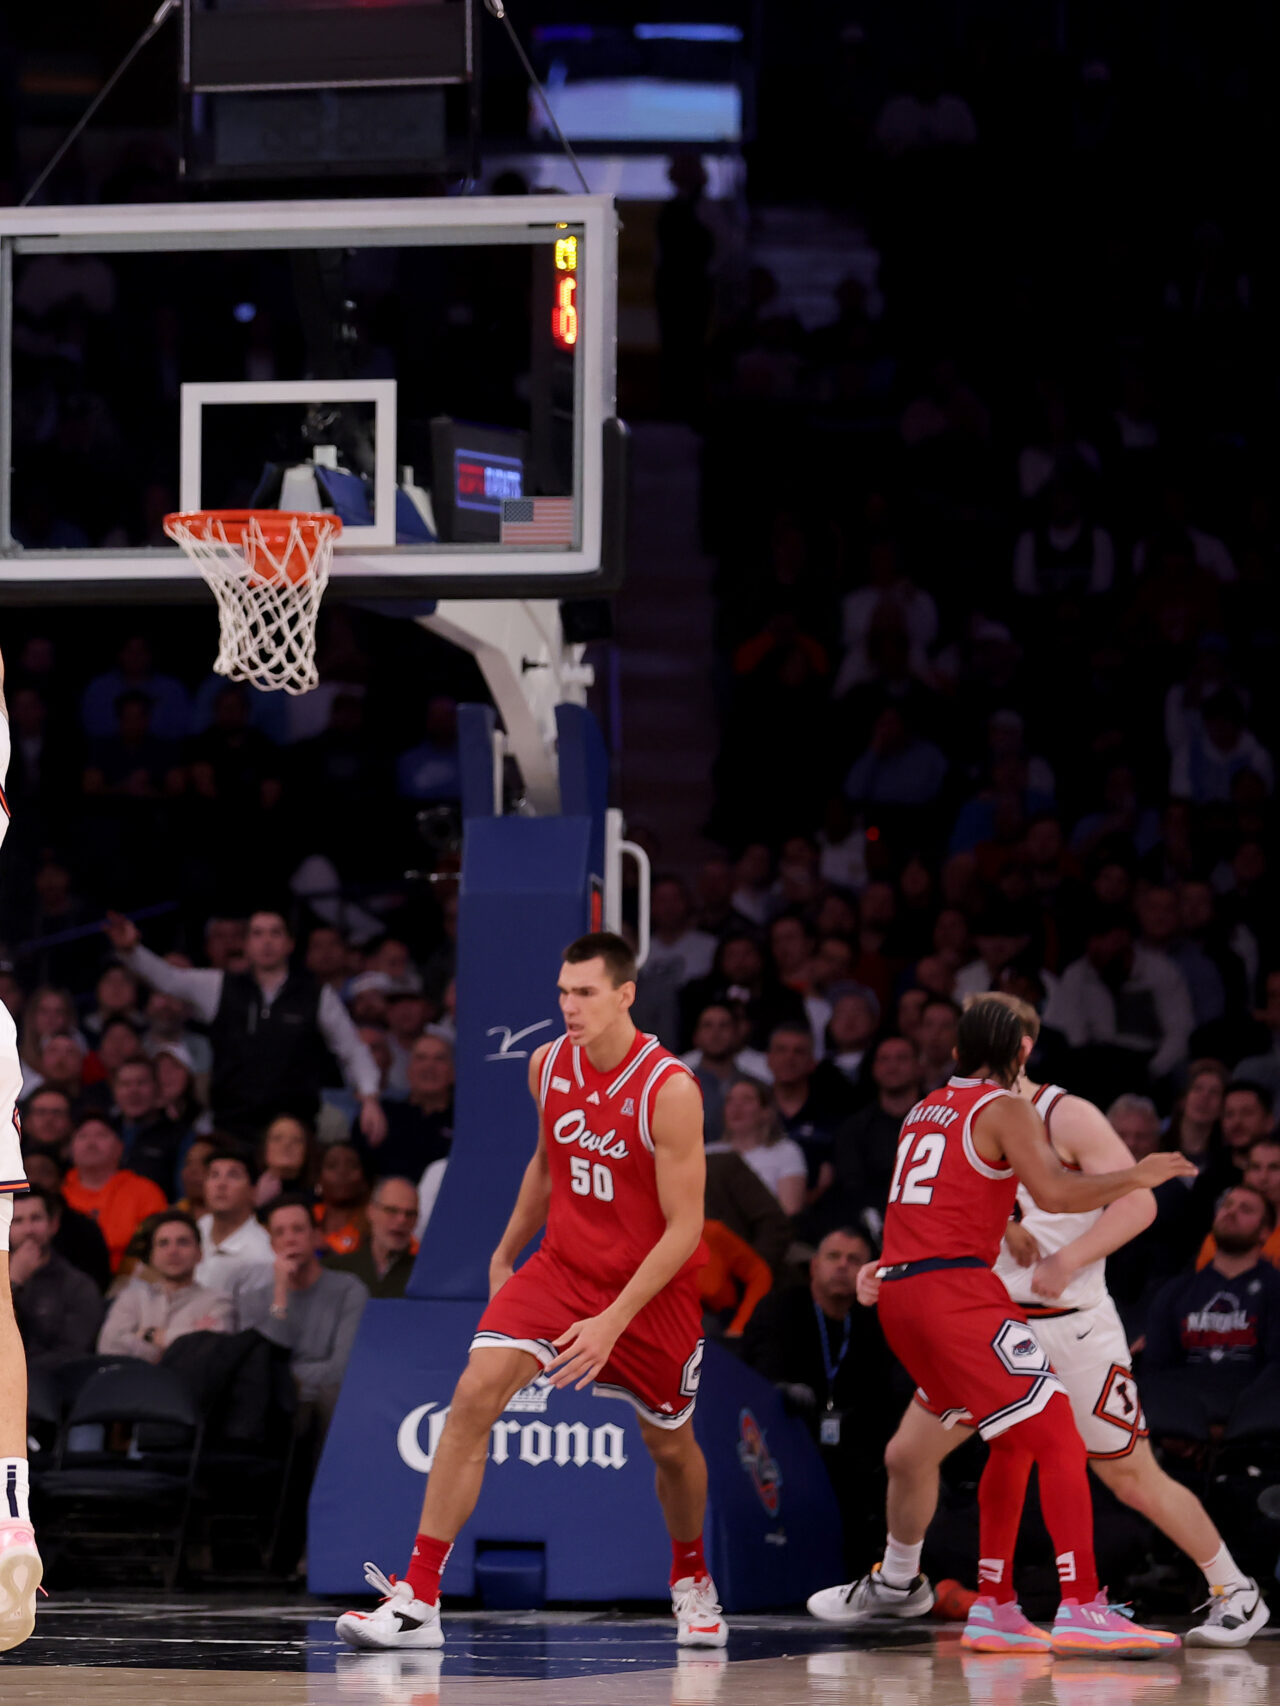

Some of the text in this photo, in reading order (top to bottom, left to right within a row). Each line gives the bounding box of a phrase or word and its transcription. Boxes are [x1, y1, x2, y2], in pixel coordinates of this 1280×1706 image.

[553, 1108, 630, 1160] Owls
[569, 1155, 614, 1202] 50
[888, 1132, 947, 1205] 12
[396, 1401, 629, 1474] Crona
